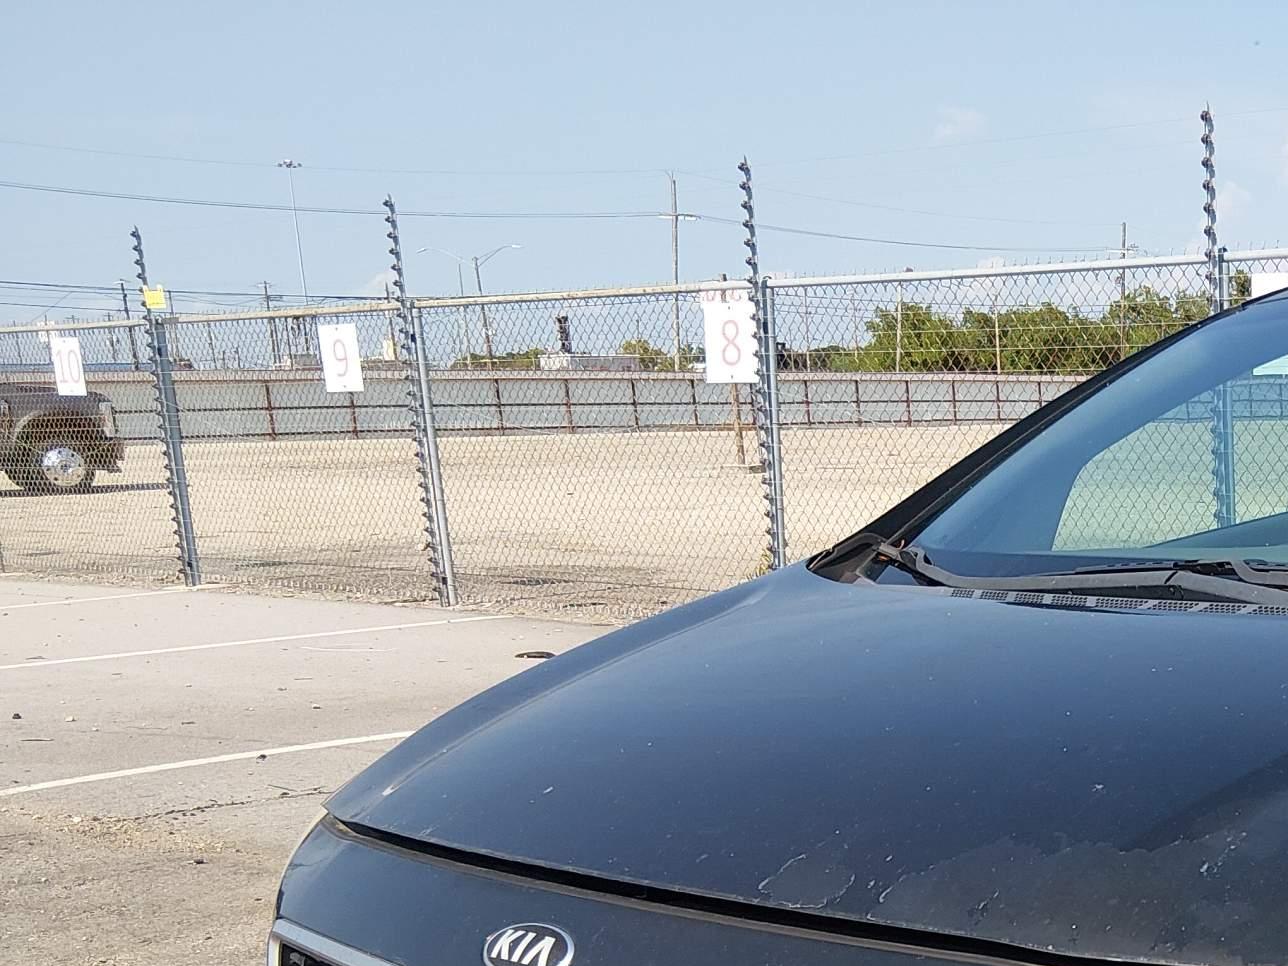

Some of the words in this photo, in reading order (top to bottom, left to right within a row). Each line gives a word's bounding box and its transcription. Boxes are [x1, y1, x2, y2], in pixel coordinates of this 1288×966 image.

[333, 338, 349, 377] 9
[722, 319, 741, 366] 8
[56, 349, 81, 384] 10
